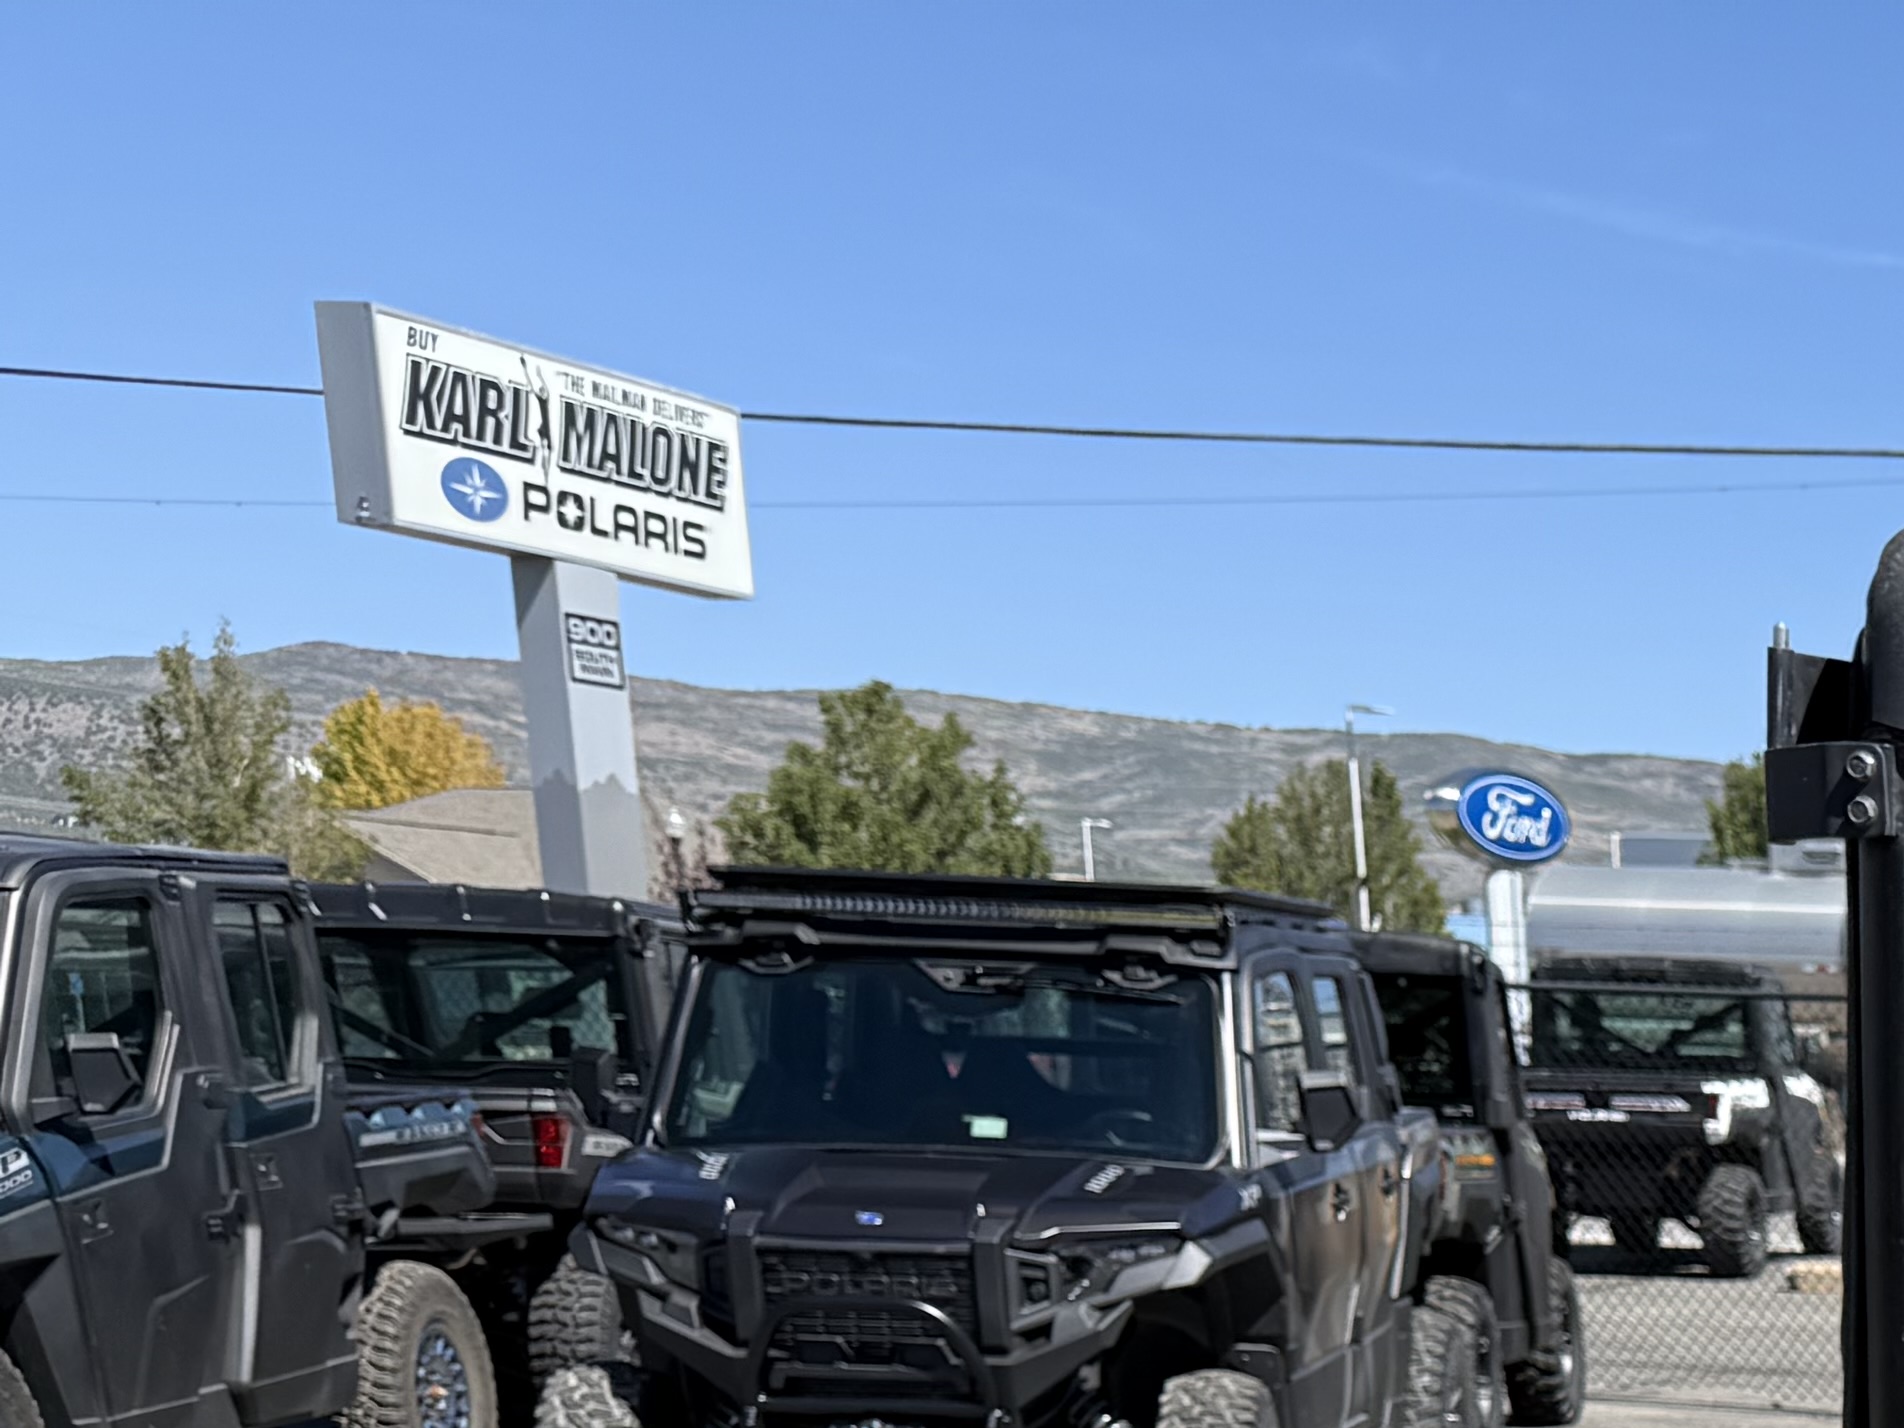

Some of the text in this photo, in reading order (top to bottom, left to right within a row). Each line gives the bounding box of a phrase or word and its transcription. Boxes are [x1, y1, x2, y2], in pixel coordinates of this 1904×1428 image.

[406, 325, 439, 352] BUY
[399, 352, 730, 513] KARL MALONE
[522, 480, 708, 561] POLARIS
[568, 616, 617, 647] 900
[1481, 784, 1553, 848] Ford
